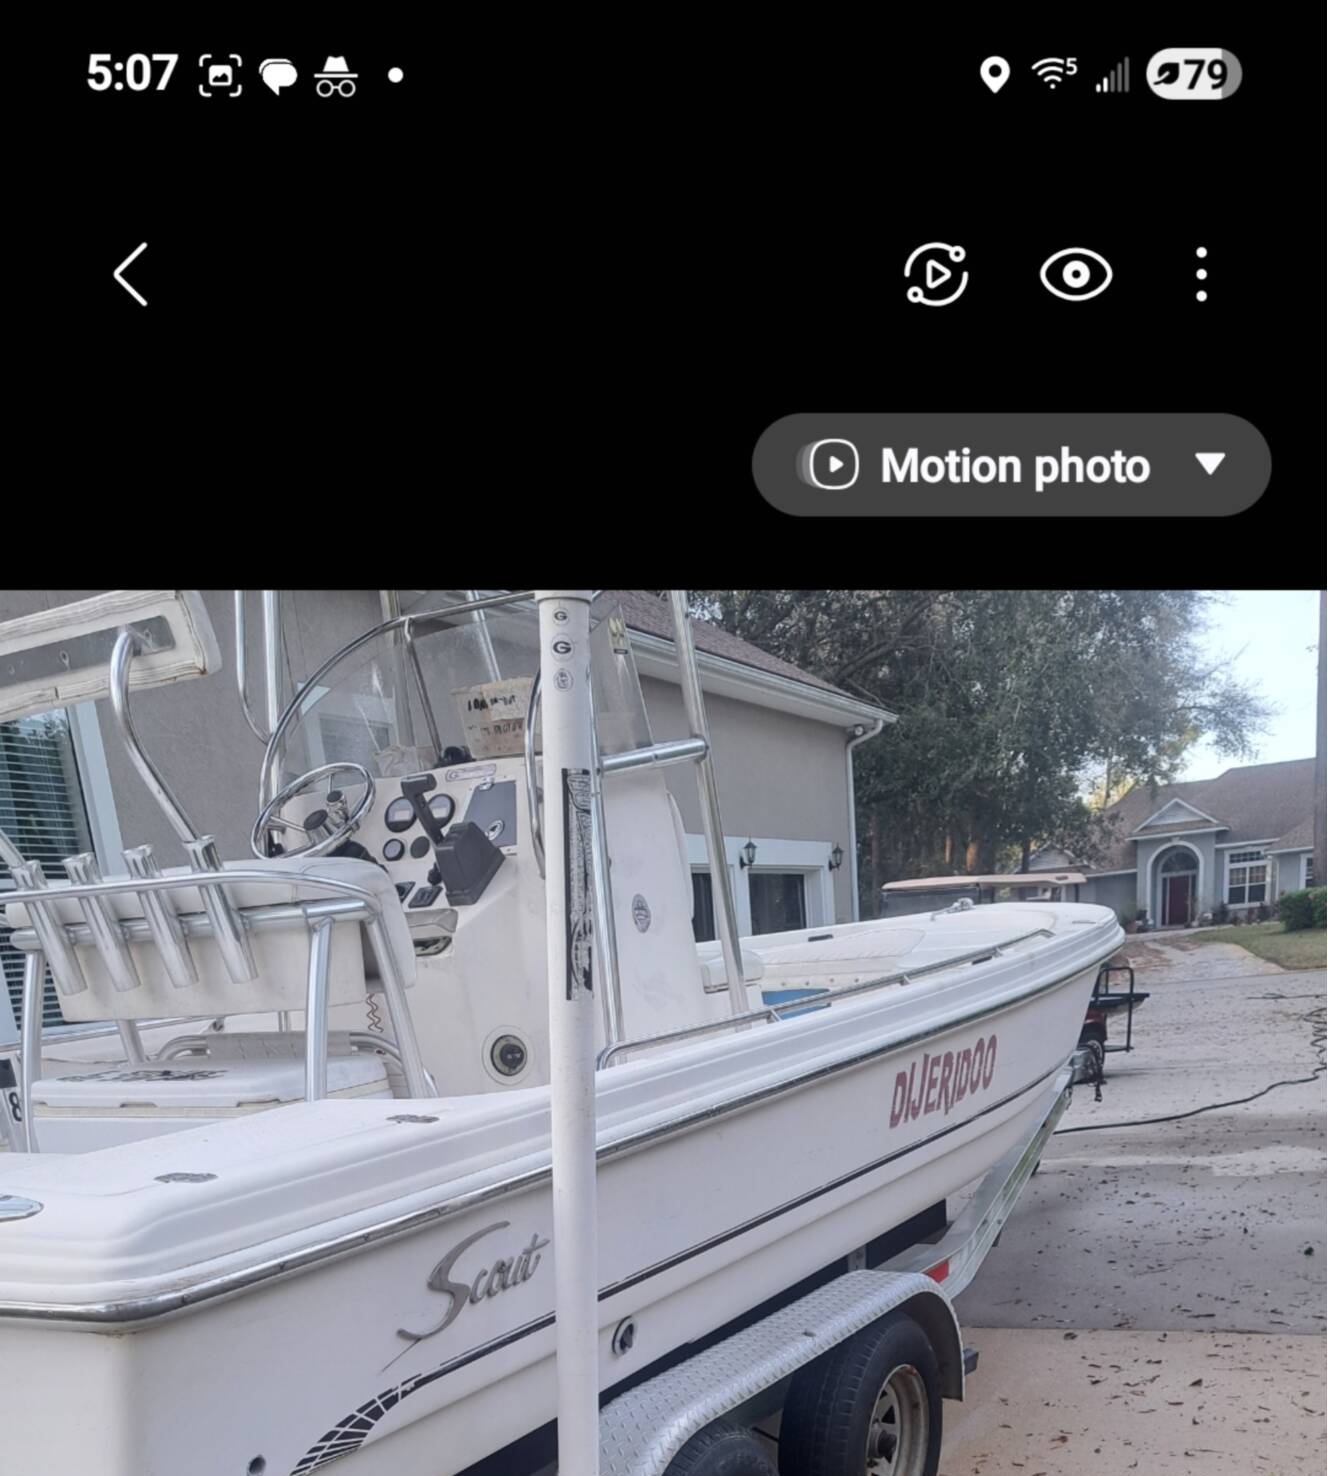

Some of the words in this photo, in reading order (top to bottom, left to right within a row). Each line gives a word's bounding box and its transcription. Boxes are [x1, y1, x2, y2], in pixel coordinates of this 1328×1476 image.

[87, 53, 179, 91] 5:07
[1066, 57, 1078, 75] 5
[1184, 58, 1228, 90] 79
[882, 446, 1022, 483] Motion
[1035, 446, 1151, 492] photo
[554, 611, 568, 621] G
[552, 641, 572, 655] G
[889, 1034, 997, 1129] DIJERIDOO
[395, 1220, 551, 1342] Scout
